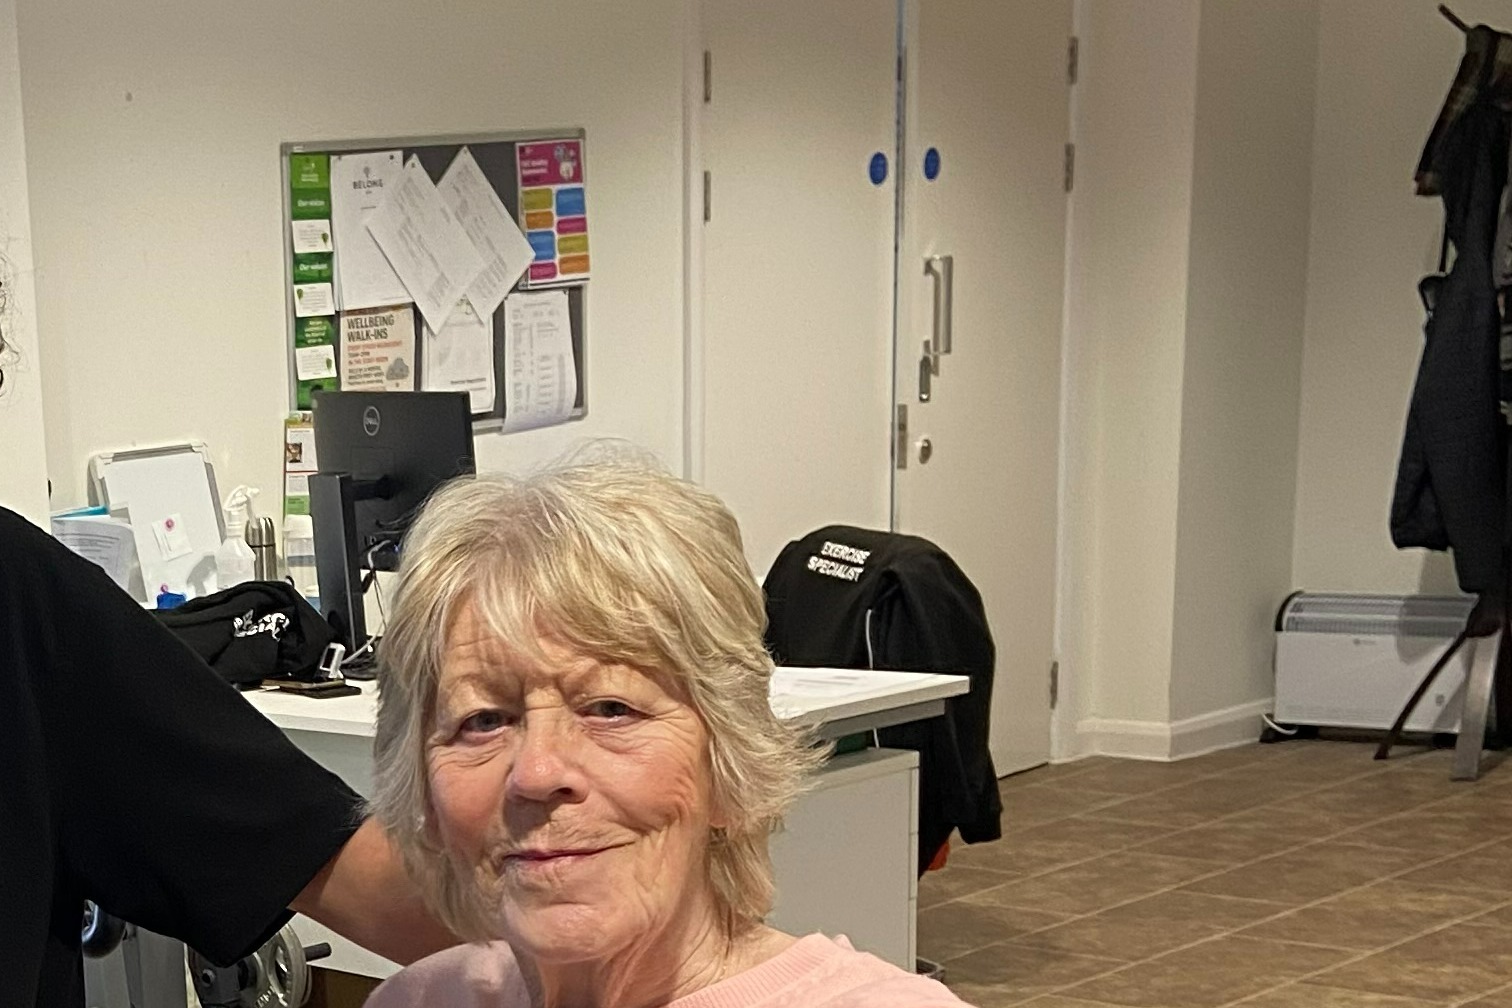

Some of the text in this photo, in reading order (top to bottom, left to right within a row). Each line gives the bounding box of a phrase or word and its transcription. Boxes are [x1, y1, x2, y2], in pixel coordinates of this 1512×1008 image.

[347, 314, 395, 330] WELLBEING
[347, 328, 388, 342] WALK-INS
[821, 541, 871, 565] EXERCISE
[808, 556, 864, 582] SPECIALIST
